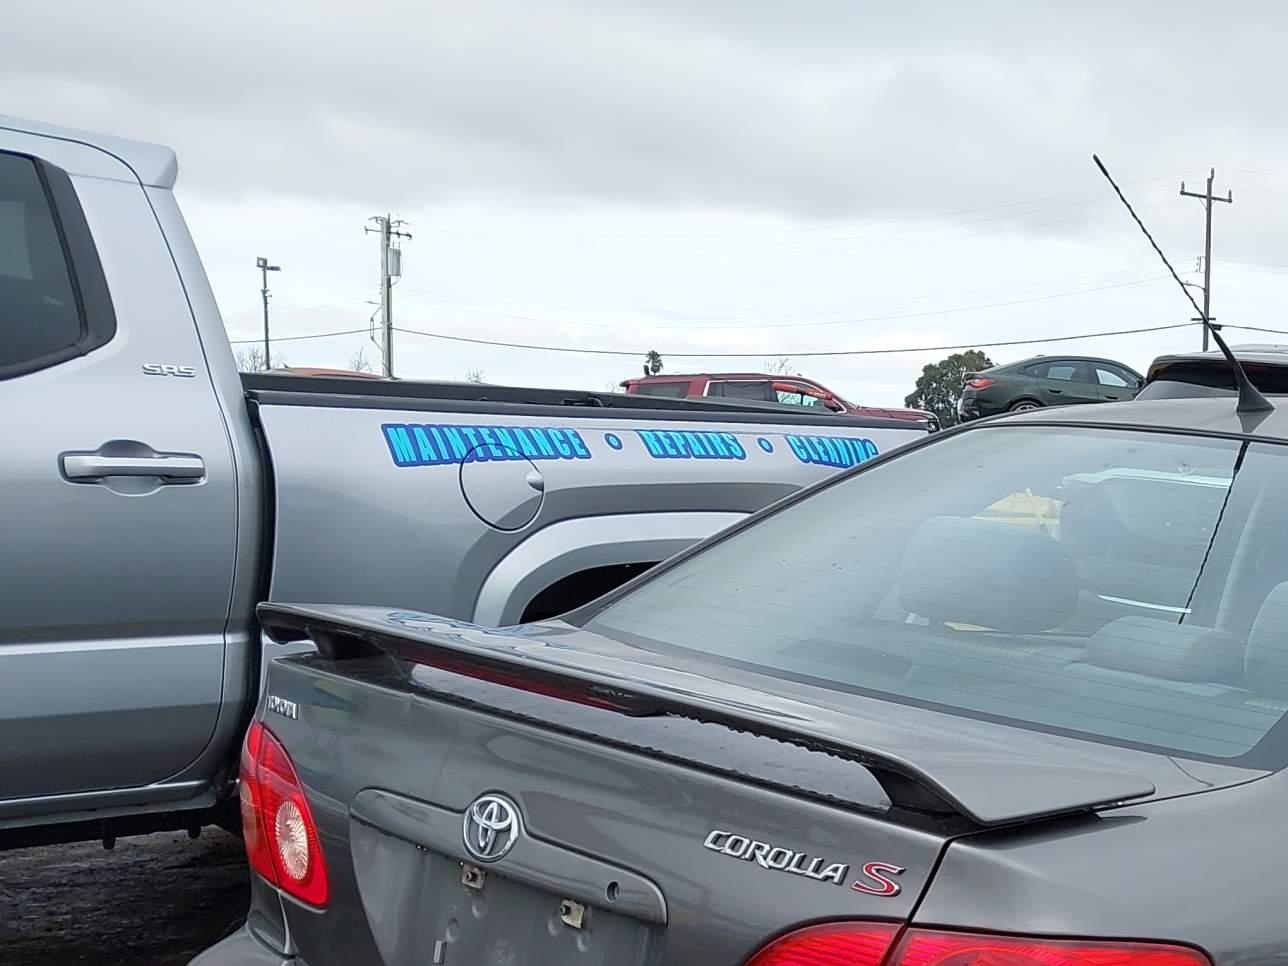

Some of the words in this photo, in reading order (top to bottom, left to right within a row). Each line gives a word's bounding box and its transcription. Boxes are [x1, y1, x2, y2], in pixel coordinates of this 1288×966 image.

[383, 425, 591, 465] MAINTENANCE
[637, 430, 747, 460] REPAIRS
[703, 830, 850, 885] COROLLA
[851, 862, 906, 897] S
